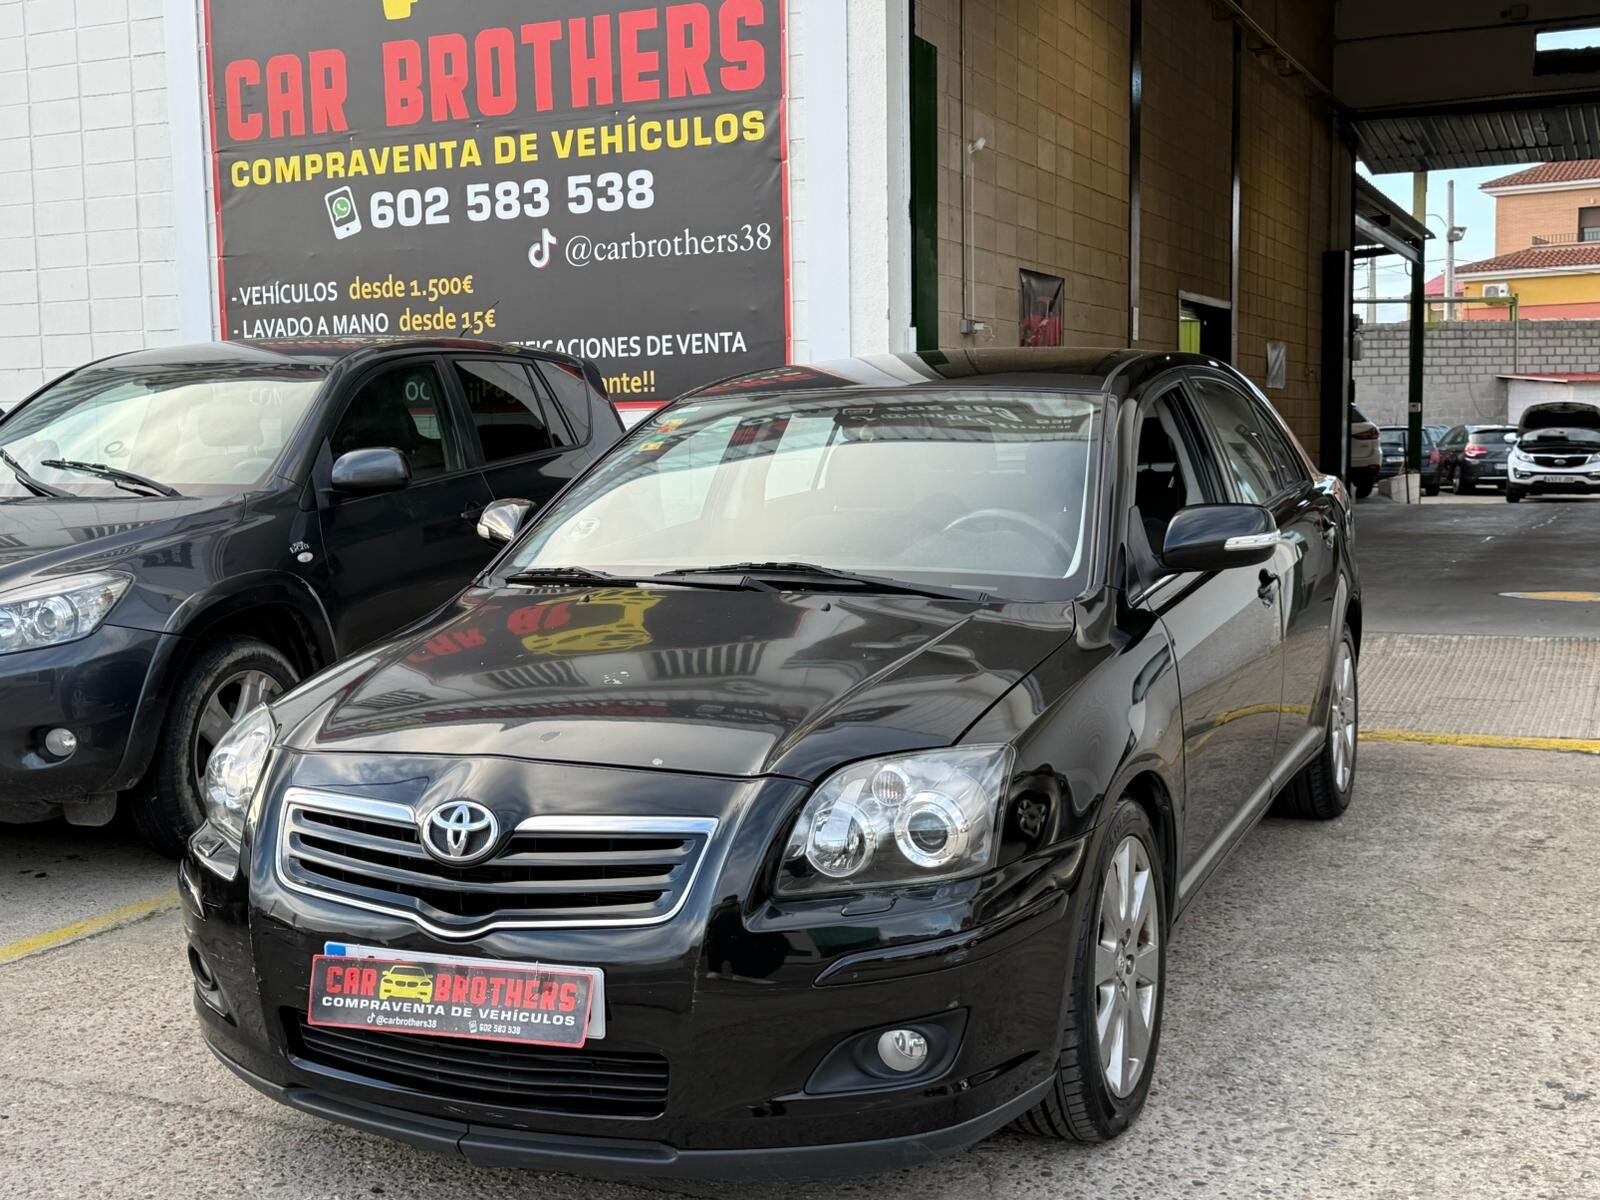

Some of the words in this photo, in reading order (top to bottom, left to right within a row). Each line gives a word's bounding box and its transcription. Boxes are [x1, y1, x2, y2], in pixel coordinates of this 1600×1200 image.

[225, 49, 349, 141] CAR
[382, 0, 765, 127] BROTHERS
[231, 138, 482, 187] COMPRAVENTA
[494, 133, 539, 165] DE
[551, 110, 766, 160] VEHÍCULOS
[370, 186, 450, 229] 602
[466, 178, 550, 222] 583
[567, 169, 655, 215] 538
[565, 223, 772, 267] @carbrothers38
[239, 281, 338, 306] VEHÍCULOS
[349, 274, 405, 300] desde
[410, 275, 474, 302] 1.500€
[243, 316, 313, 339] LAVADO
[317, 316, 330, 336] A
[333, 312, 389, 335] MANO
[399, 306, 456, 332] desde
[462, 308, 496, 334] 15€
[646, 334, 673, 357] DE
[676, 331, 748, 355] VENTA
[326, 966, 378, 996] CAR
[434, 973, 578, 1013] BROTHERS
[322, 996, 446, 1016] COMPRAVENTA
[451, 1006, 473, 1018] DE
[478, 1008, 576, 1026] VEHÍCULOS
[376, 1014, 437, 1029] @carbrothers38
